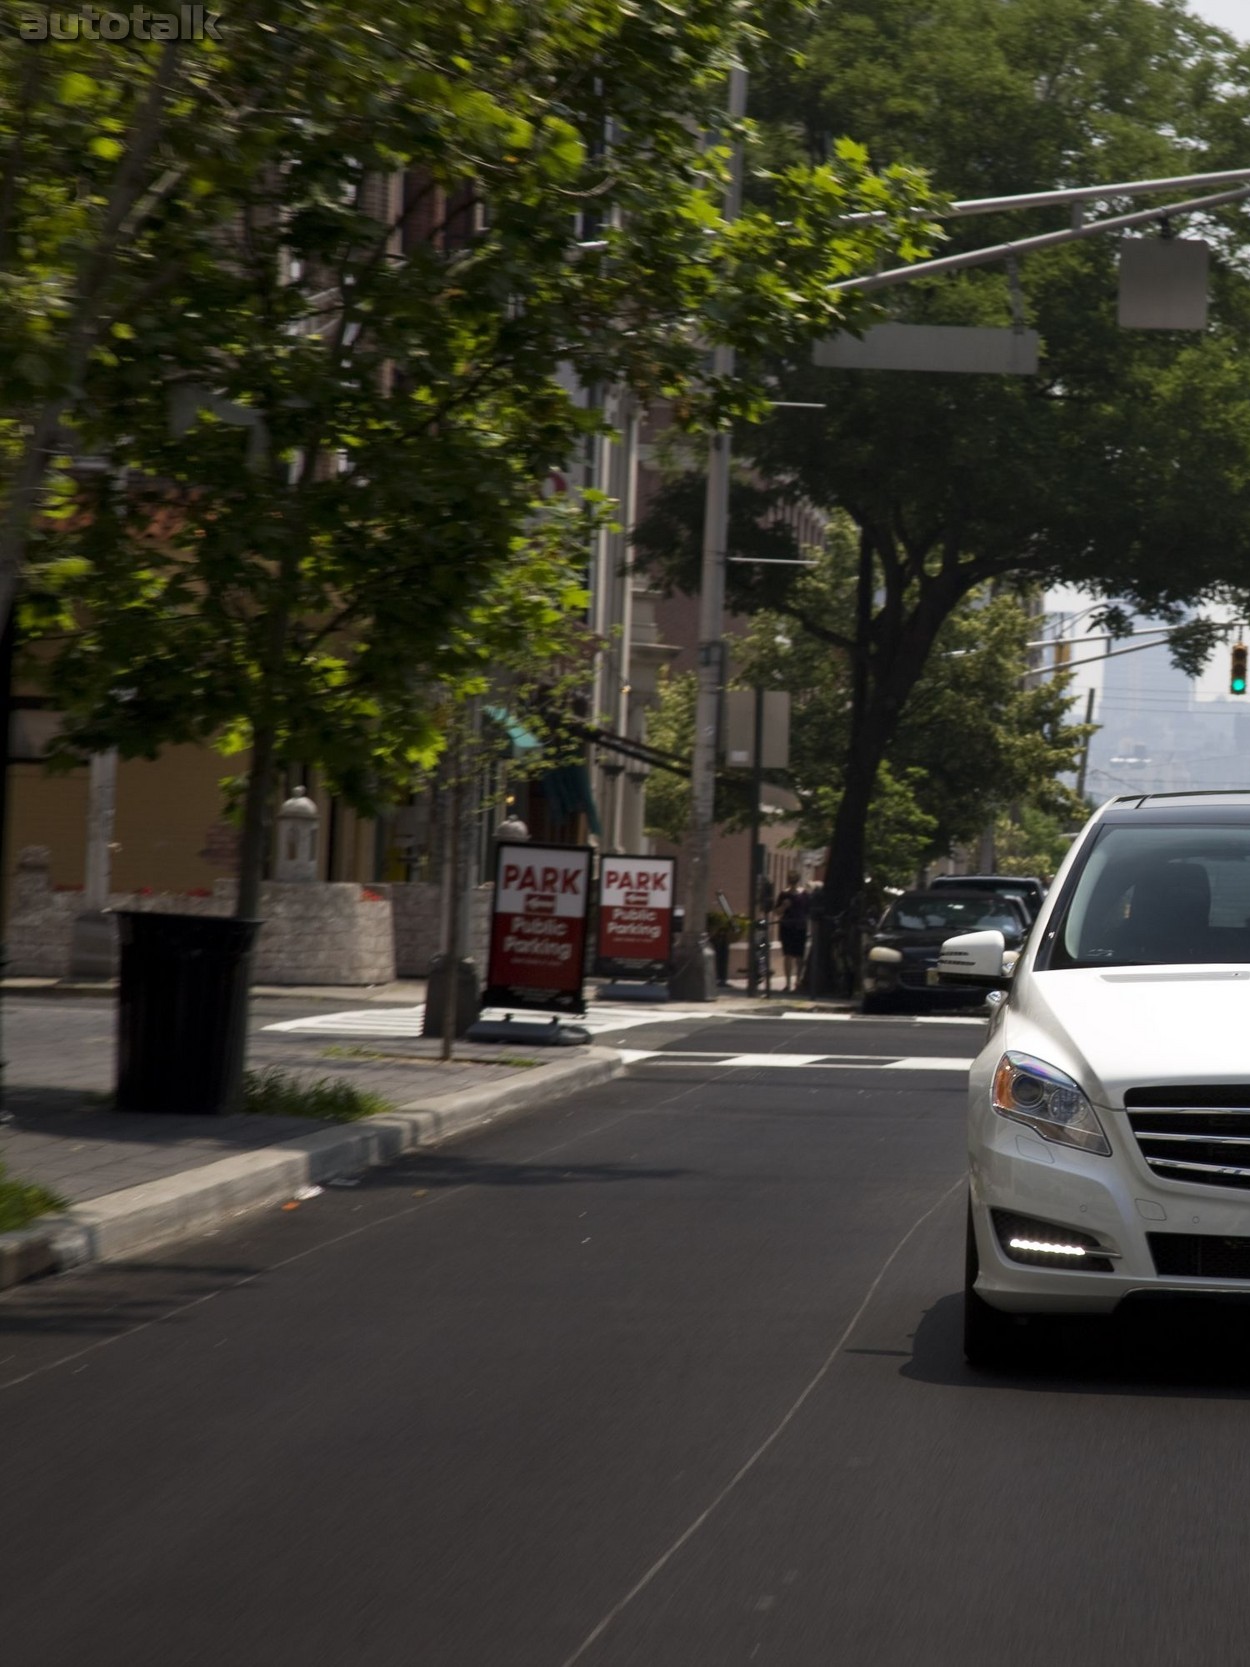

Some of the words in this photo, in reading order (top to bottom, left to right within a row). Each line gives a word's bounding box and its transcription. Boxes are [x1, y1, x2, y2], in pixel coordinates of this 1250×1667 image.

[503, 864, 582, 894] PARK
[605, 870, 668, 891] PARK
[612, 908, 657, 921] Public
[511, 917, 568, 936] Public
[607, 922, 662, 938] Parking
[503, 935, 573, 961] Parking
